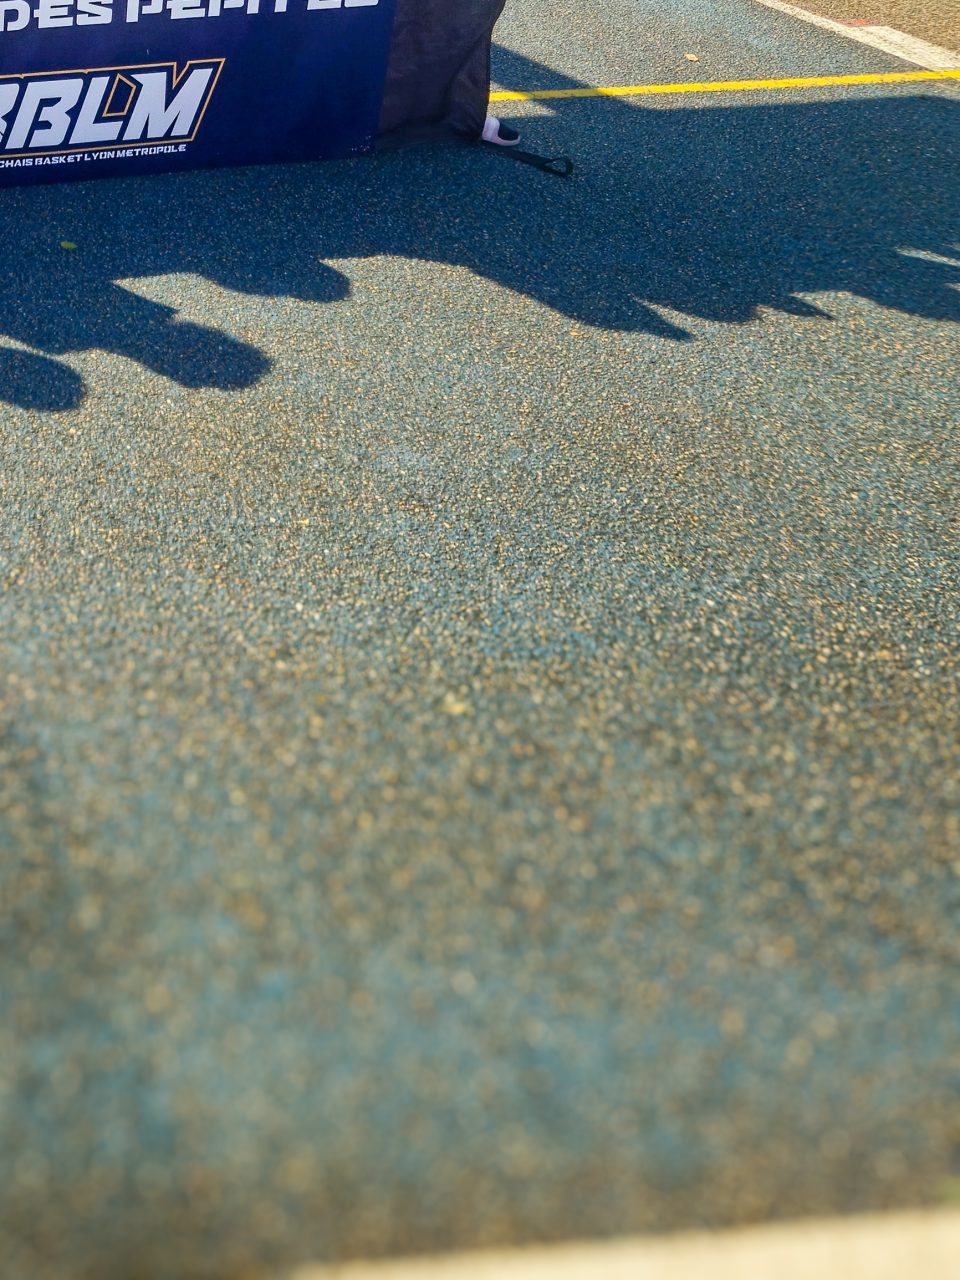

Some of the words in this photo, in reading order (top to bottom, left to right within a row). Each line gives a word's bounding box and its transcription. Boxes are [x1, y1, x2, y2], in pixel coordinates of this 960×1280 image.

[35, 154, 83, 165] BASKET
[84, 150, 115, 161] LYON
[116, 144, 186, 158] METROPOLE
